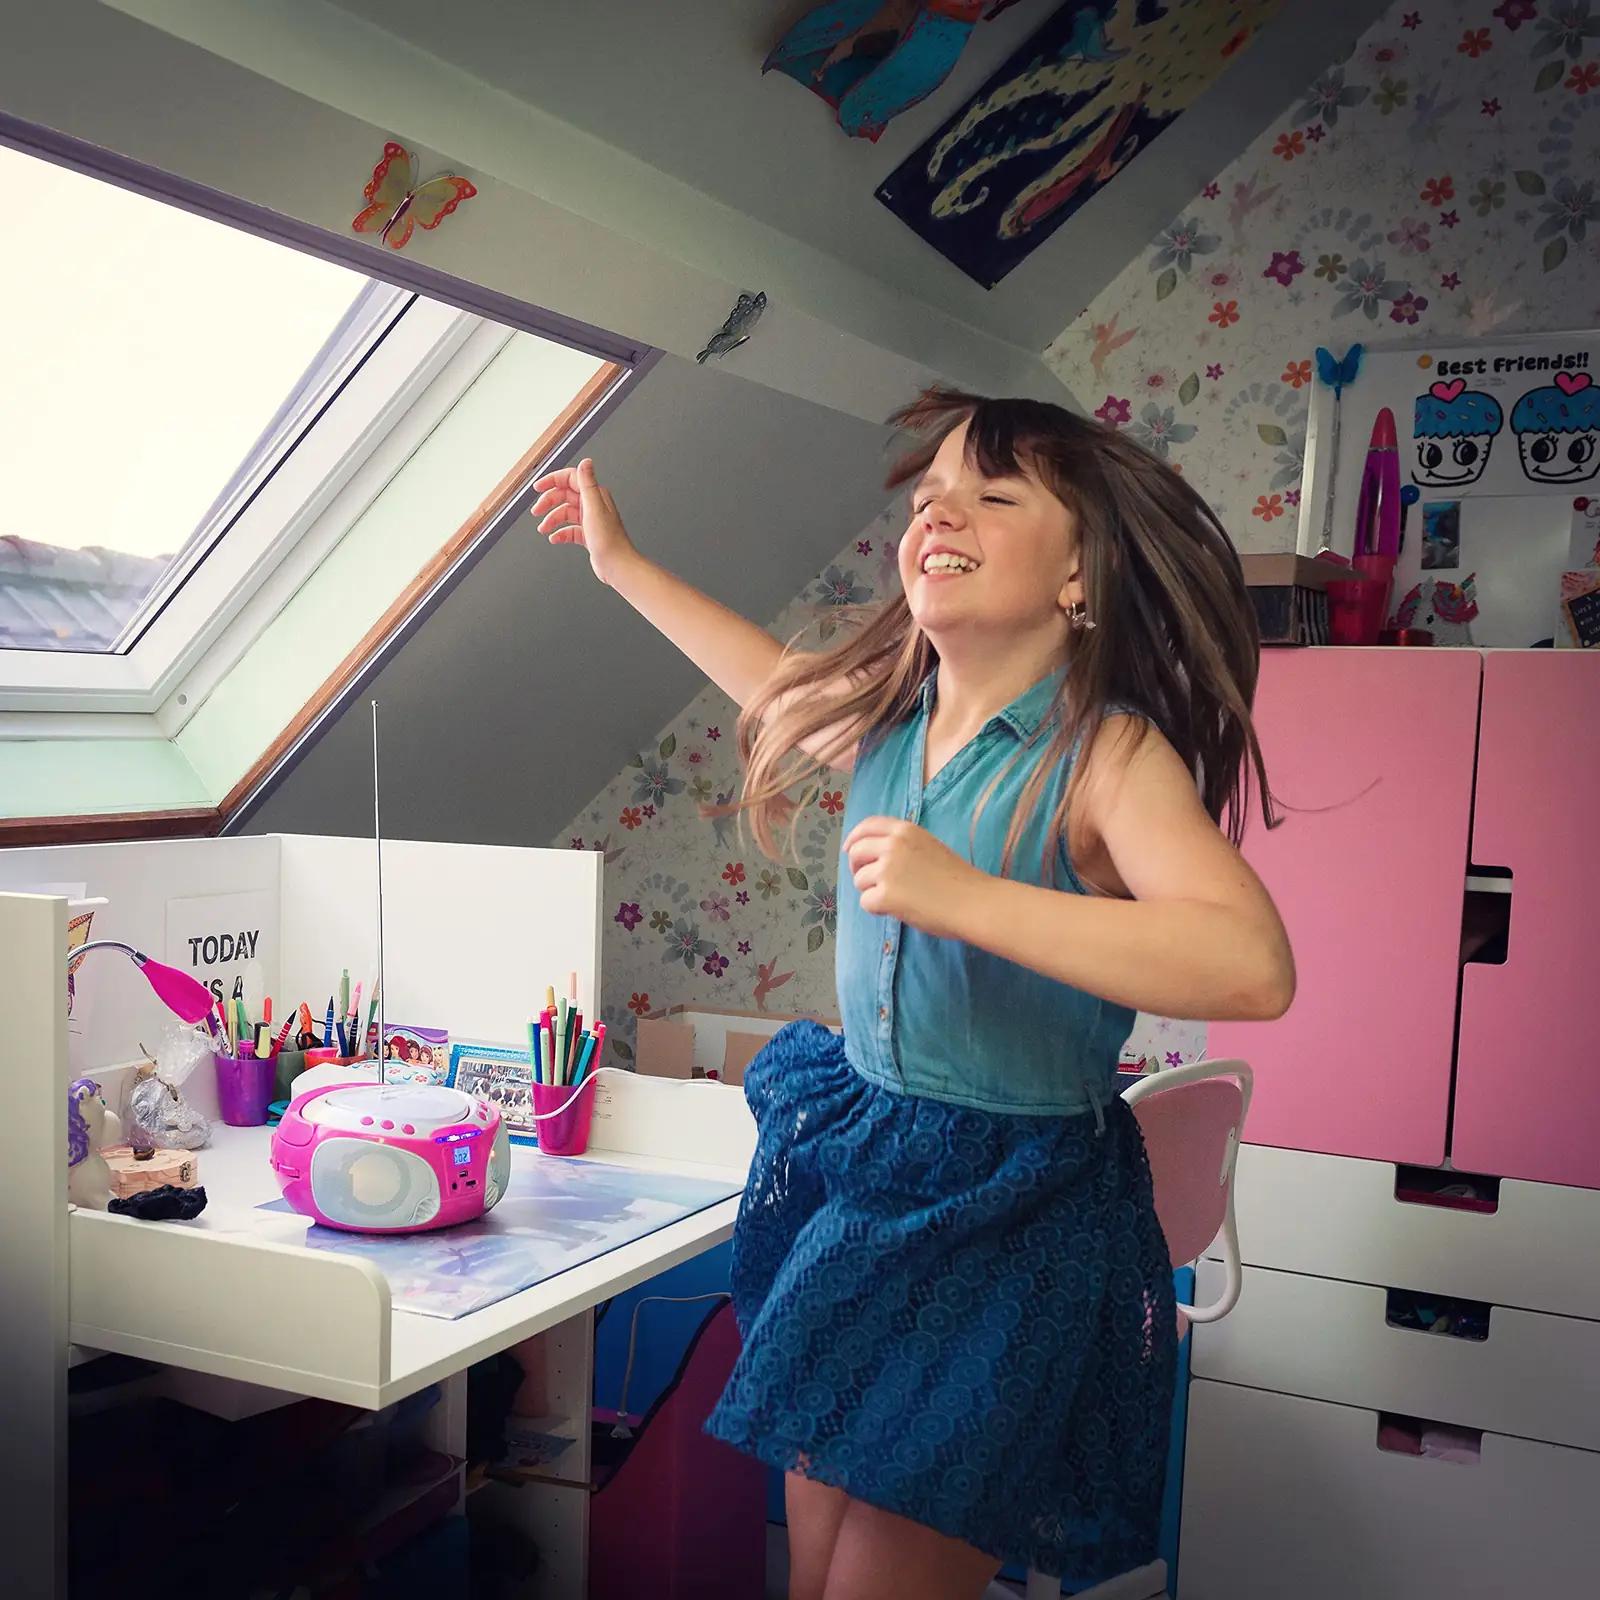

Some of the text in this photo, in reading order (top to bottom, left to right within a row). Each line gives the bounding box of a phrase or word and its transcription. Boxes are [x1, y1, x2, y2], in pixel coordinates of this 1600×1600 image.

[1437, 352, 1589, 376] Best Friends!!
[188, 930, 260, 967] TODAY
[203, 975, 243, 1004] S A
